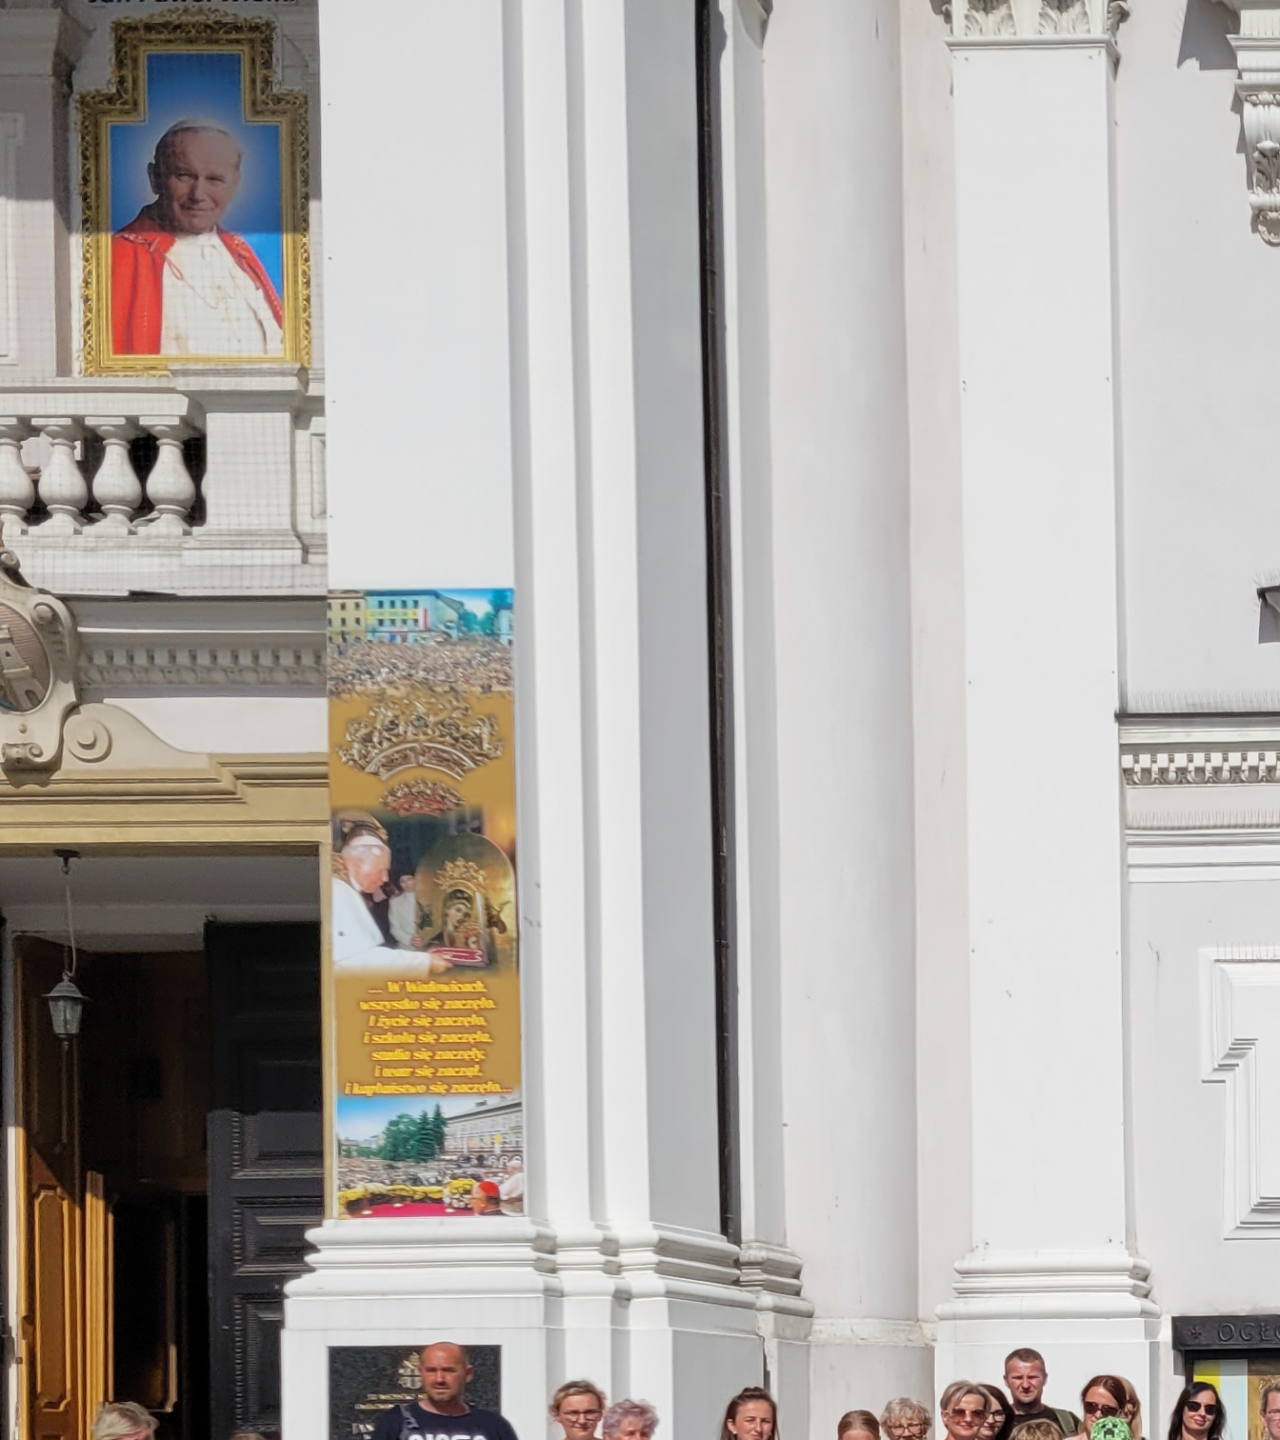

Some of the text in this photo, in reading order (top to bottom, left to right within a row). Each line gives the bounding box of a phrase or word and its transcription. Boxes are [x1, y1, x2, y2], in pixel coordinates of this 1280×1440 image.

[421, 998, 442, 1011] się
[413, 1015, 433, 1028] się
[418, 1031, 438, 1044] się
[413, 1048, 433, 1062] się
[415, 1065, 435, 1078] się
[429, 1082, 449, 1096] się
